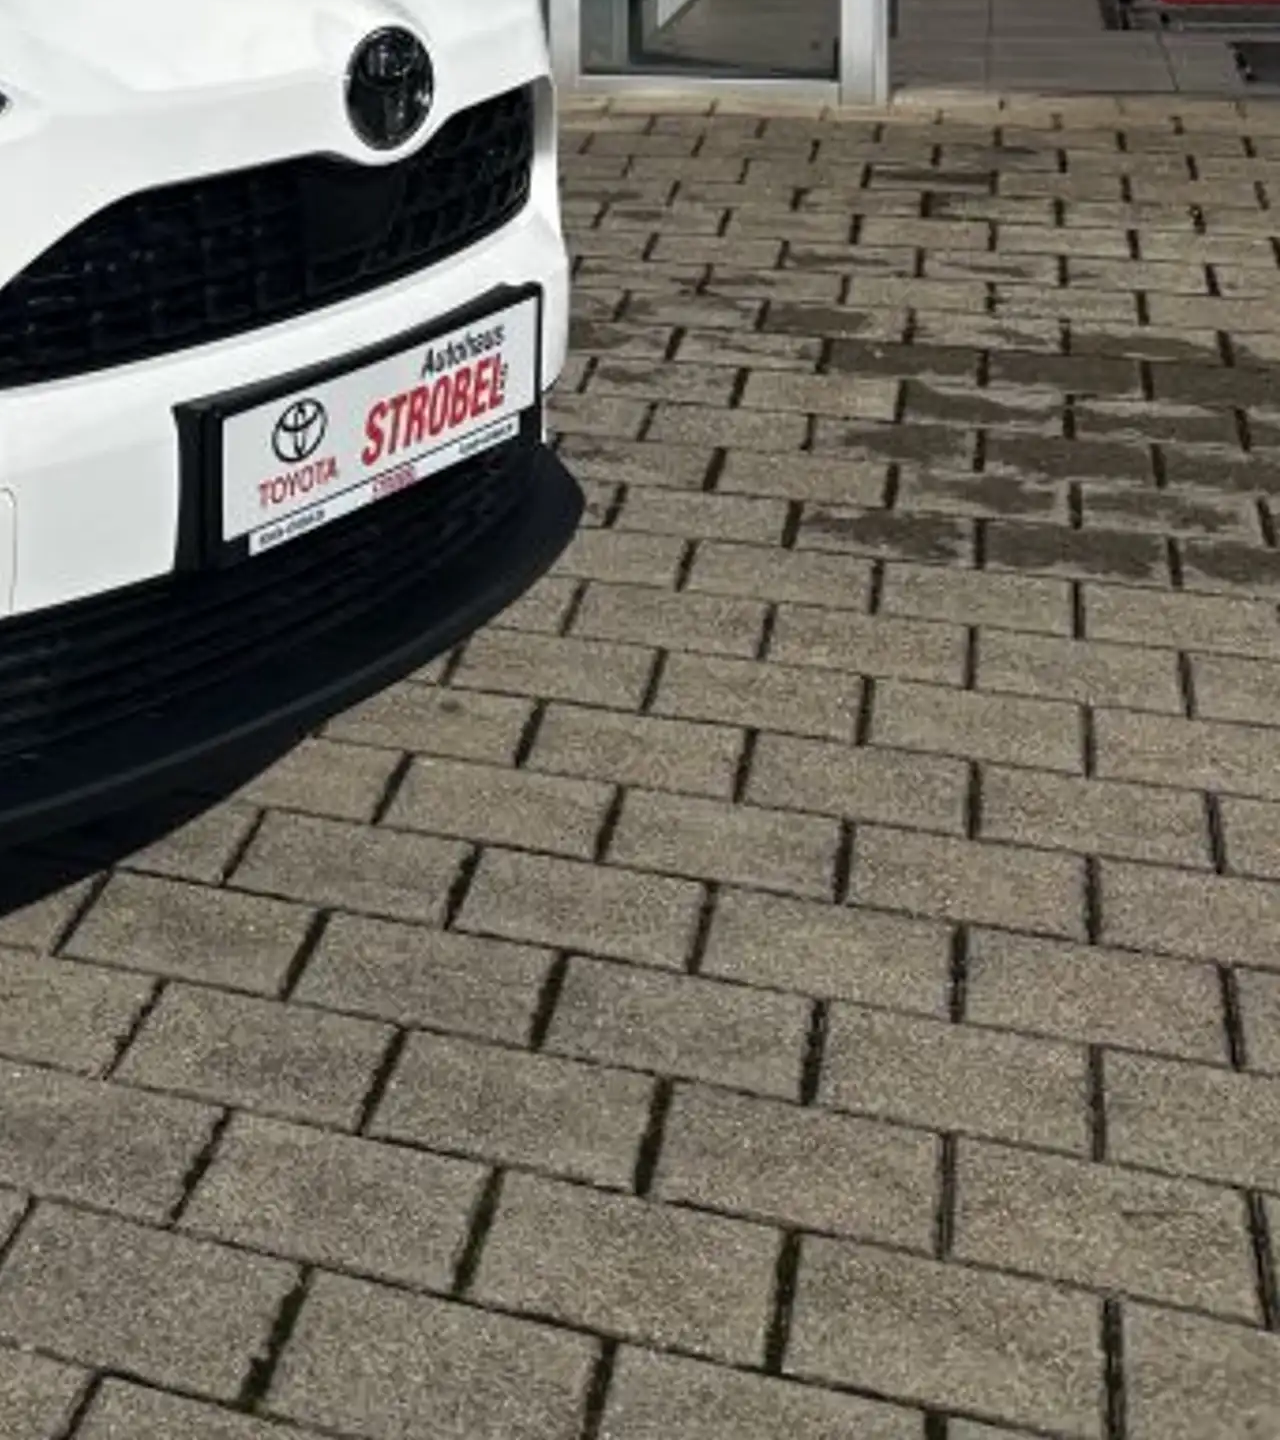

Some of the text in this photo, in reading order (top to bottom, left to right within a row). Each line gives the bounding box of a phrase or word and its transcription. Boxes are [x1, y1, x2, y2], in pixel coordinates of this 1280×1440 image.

[421, 325, 506, 377] Autohaus
[360, 353, 504, 466] STROBEL
[257, 456, 339, 508] TOYOTA
